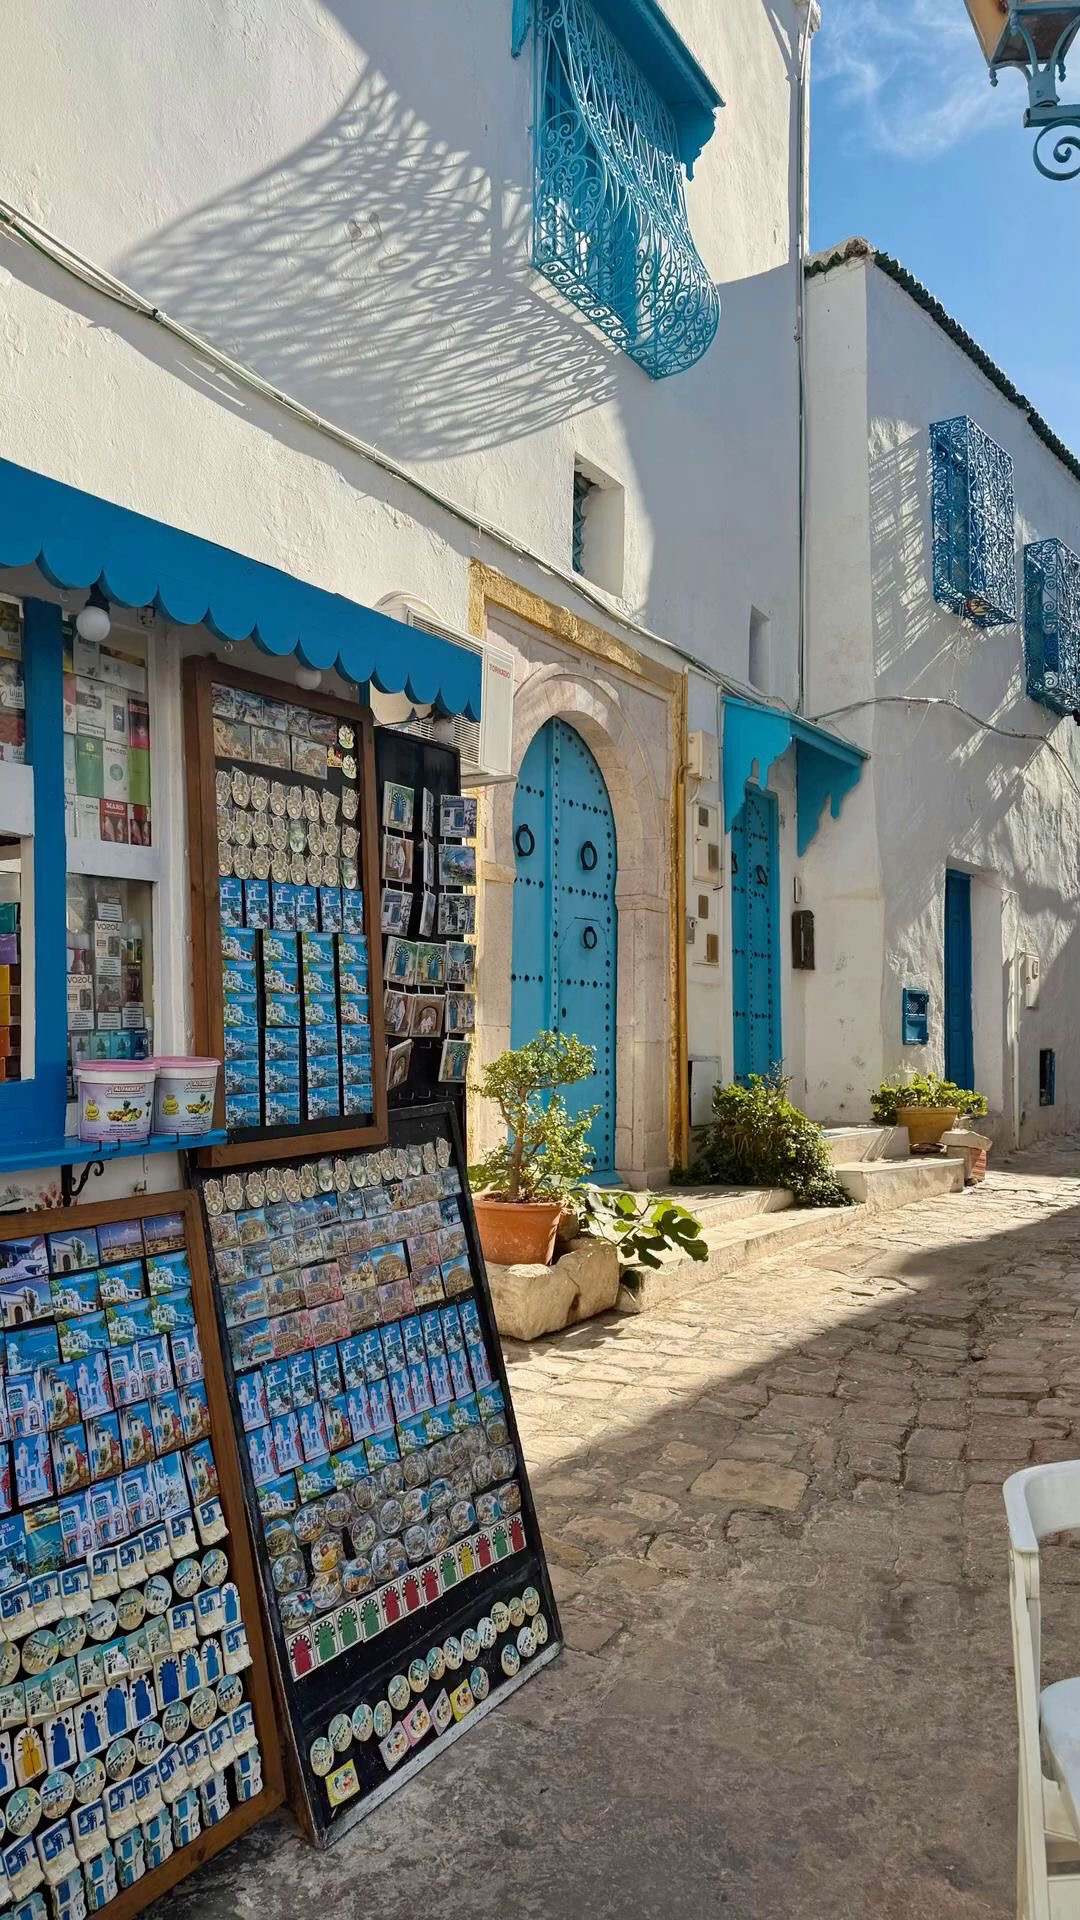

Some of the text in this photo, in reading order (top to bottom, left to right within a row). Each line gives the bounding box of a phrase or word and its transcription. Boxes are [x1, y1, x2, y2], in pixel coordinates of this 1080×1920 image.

[489, 664, 510, 678] TORNADO
[96, 922, 120, 931] VOZOL
[67, 975, 92, 984] VOZOL
